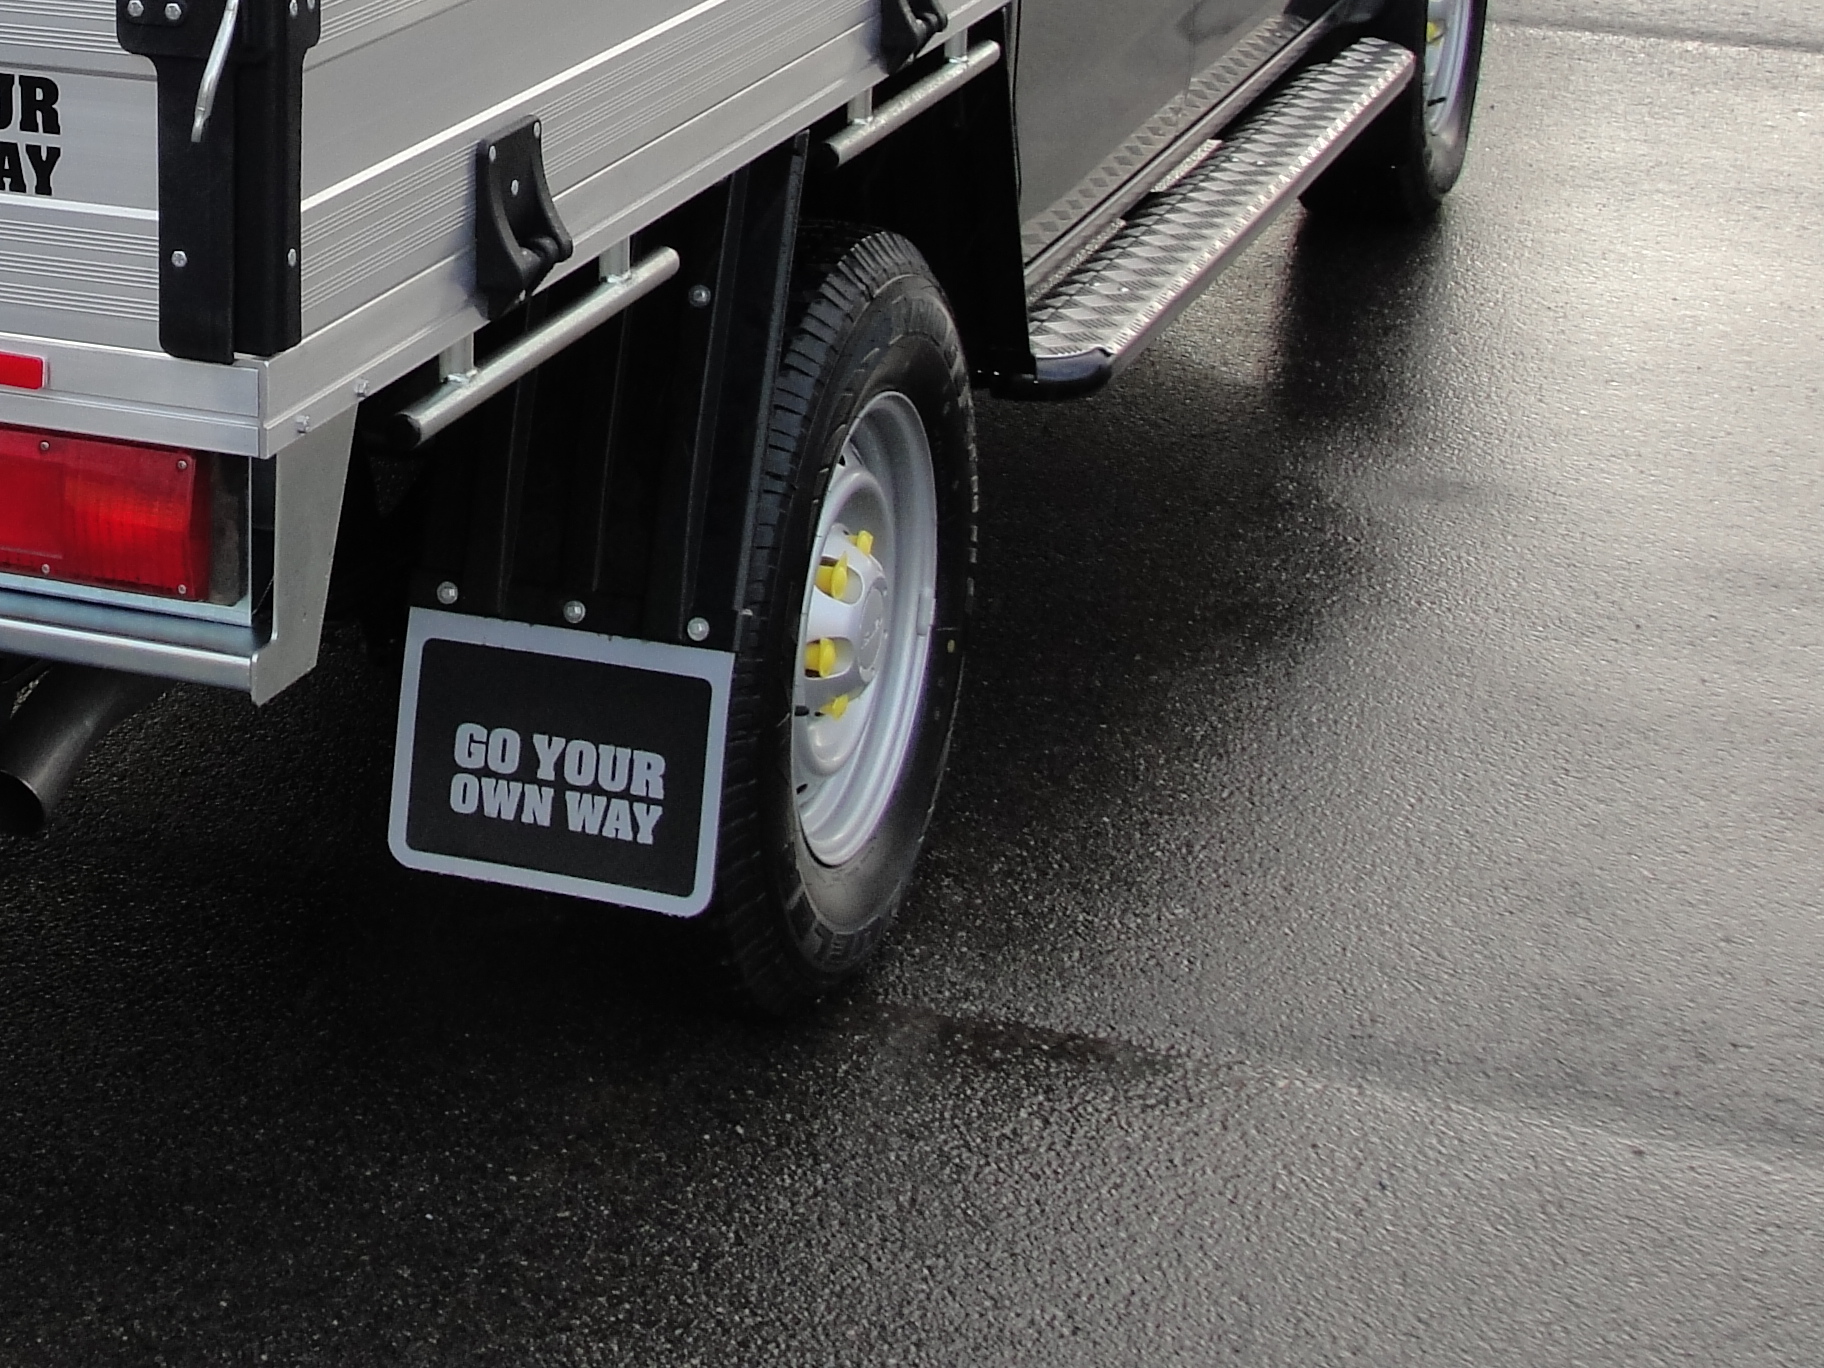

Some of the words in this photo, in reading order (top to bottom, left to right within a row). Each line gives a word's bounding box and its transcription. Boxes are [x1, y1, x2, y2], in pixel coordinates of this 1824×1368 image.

[453, 722, 521, 775] GO
[532, 733, 666, 801] YOUR
[449, 772, 555, 827] OWN
[565, 790, 663, 845] WAY
